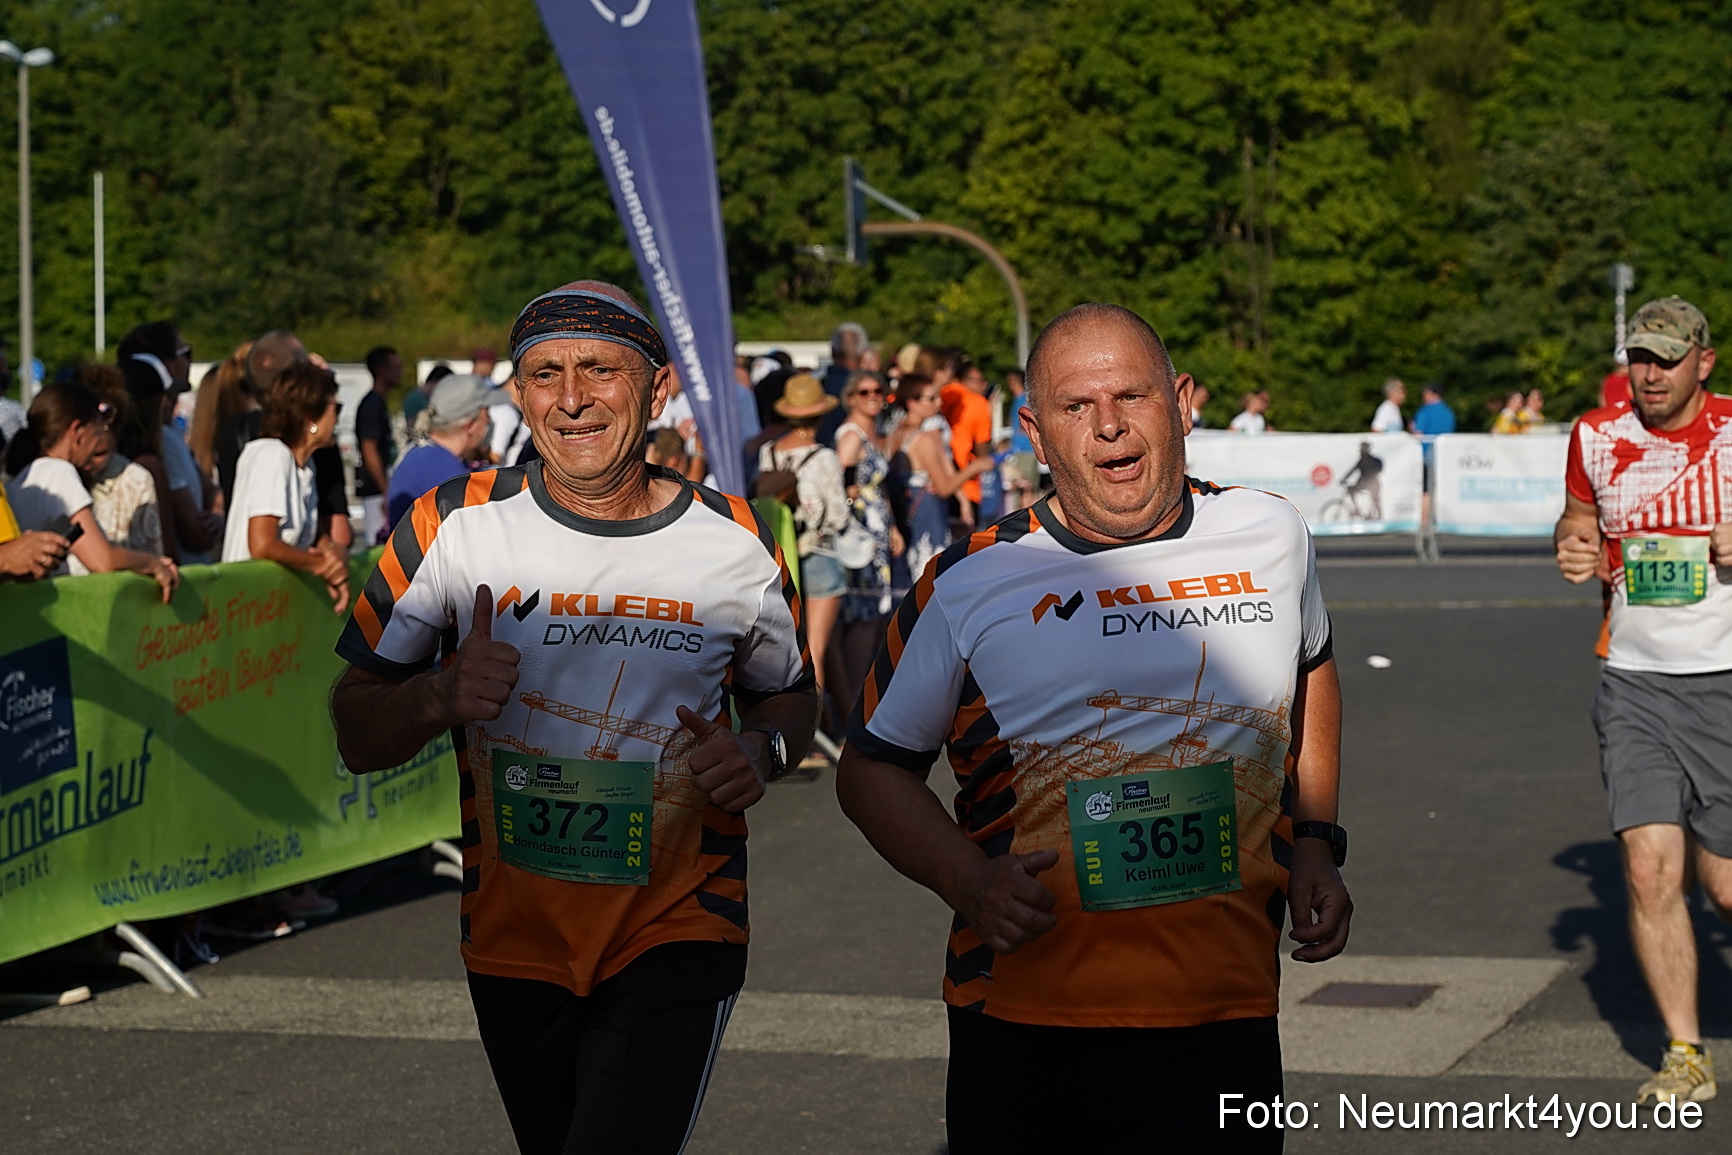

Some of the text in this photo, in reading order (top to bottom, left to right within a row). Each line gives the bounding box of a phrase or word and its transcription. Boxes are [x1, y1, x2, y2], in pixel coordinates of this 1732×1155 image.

[1635, 560, 1690, 583] 1131
[1096, 571, 1268, 608] KLEBL
[550, 592, 704, 627] KLEBL
[1102, 601, 1274, 637] DYNAMICS
[542, 623, 704, 654] DYNAMICS
[529, 778, 580, 790] Firmenlauf
[547, 788, 579, 796] neumarkt
[1116, 793, 1171, 811] Firmenlauf
[1138, 802, 1171, 813] neumarkt
[502, 804, 514, 845] RUN
[527, 797, 609, 843] 372
[1118, 812, 1205, 863] 365
[514, 835, 627, 860] Horndasch Günter
[627, 811, 644, 867] 2022
[1219, 813, 1233, 873] 2022
[0, 852, 50, 895] markt
[1084, 840, 1103, 886] RUN
[1125, 861, 1205, 883] Keiml Uwe
[1170, 881, 1186, 890] GmbH
